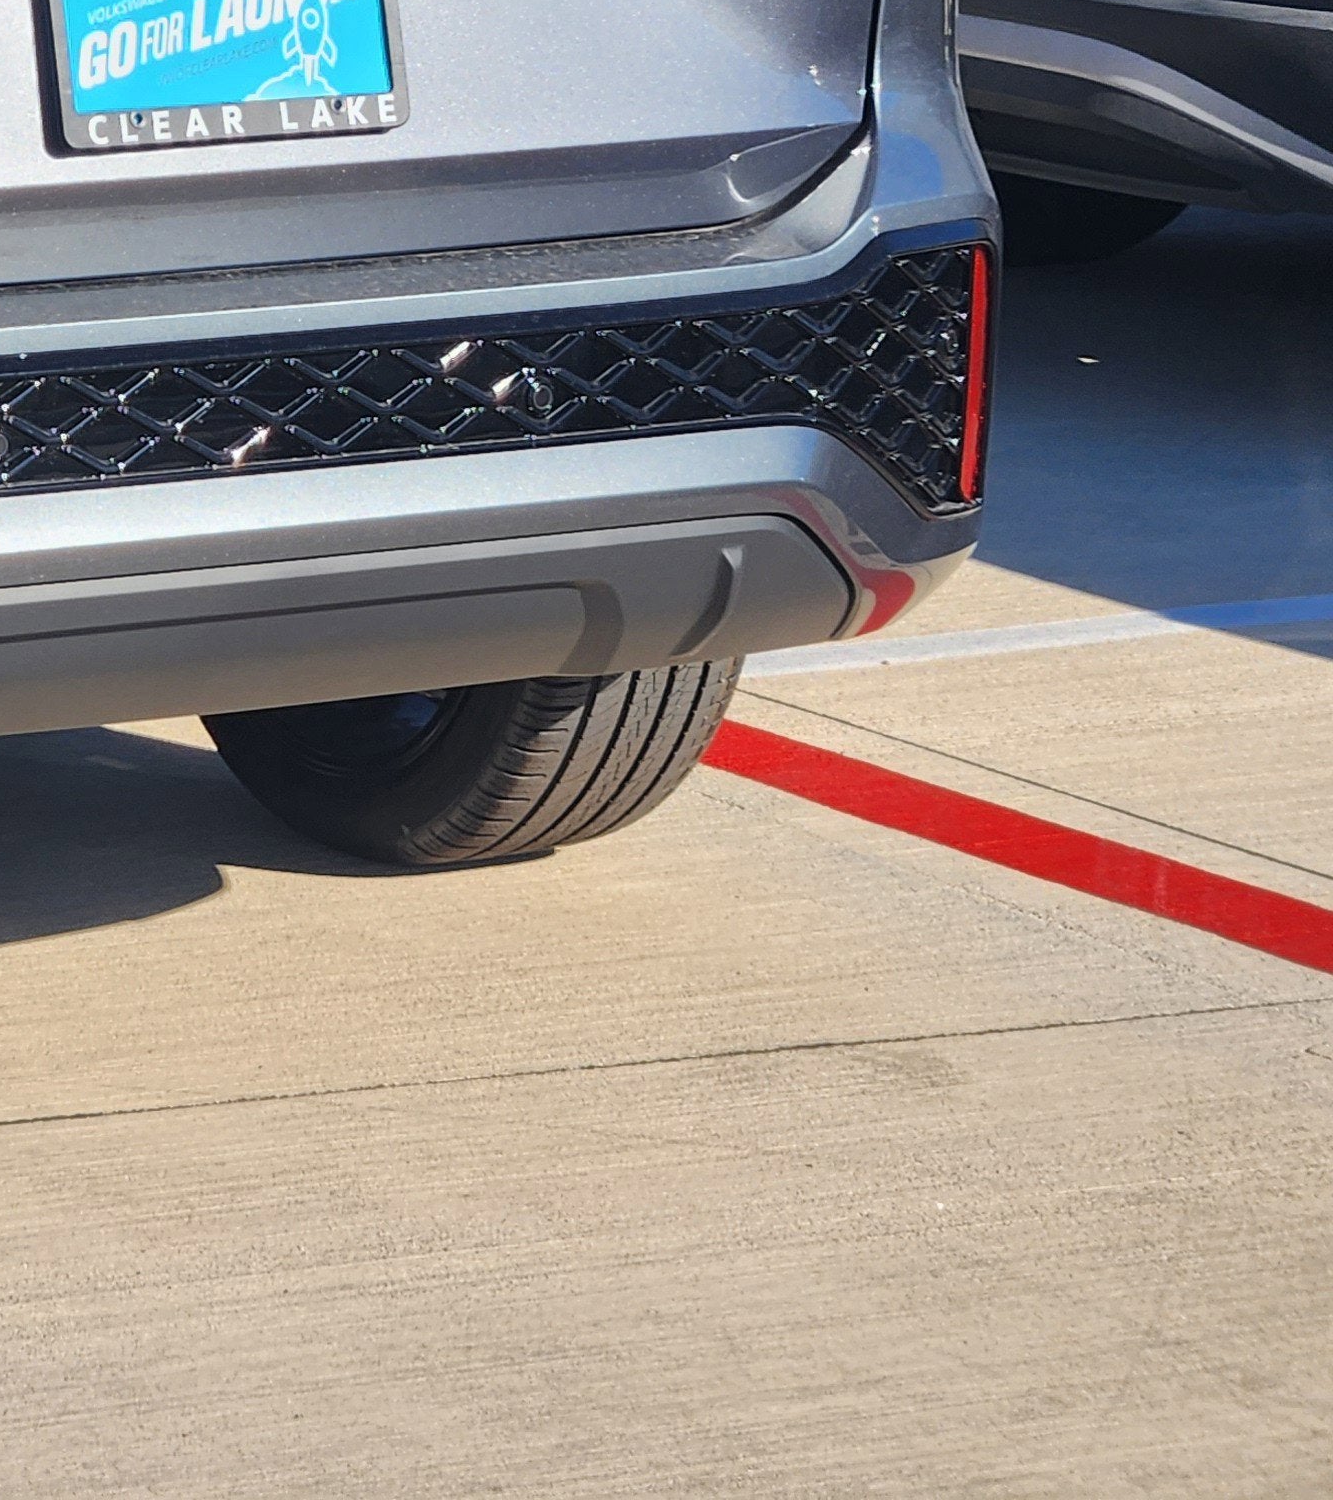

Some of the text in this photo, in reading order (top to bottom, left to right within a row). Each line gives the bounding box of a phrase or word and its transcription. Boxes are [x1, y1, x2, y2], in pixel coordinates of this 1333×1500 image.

[78, 20, 138, 90] GO
[140, 11, 184, 65] FOR
[88, 94, 397, 146] CLEAR LAKE
